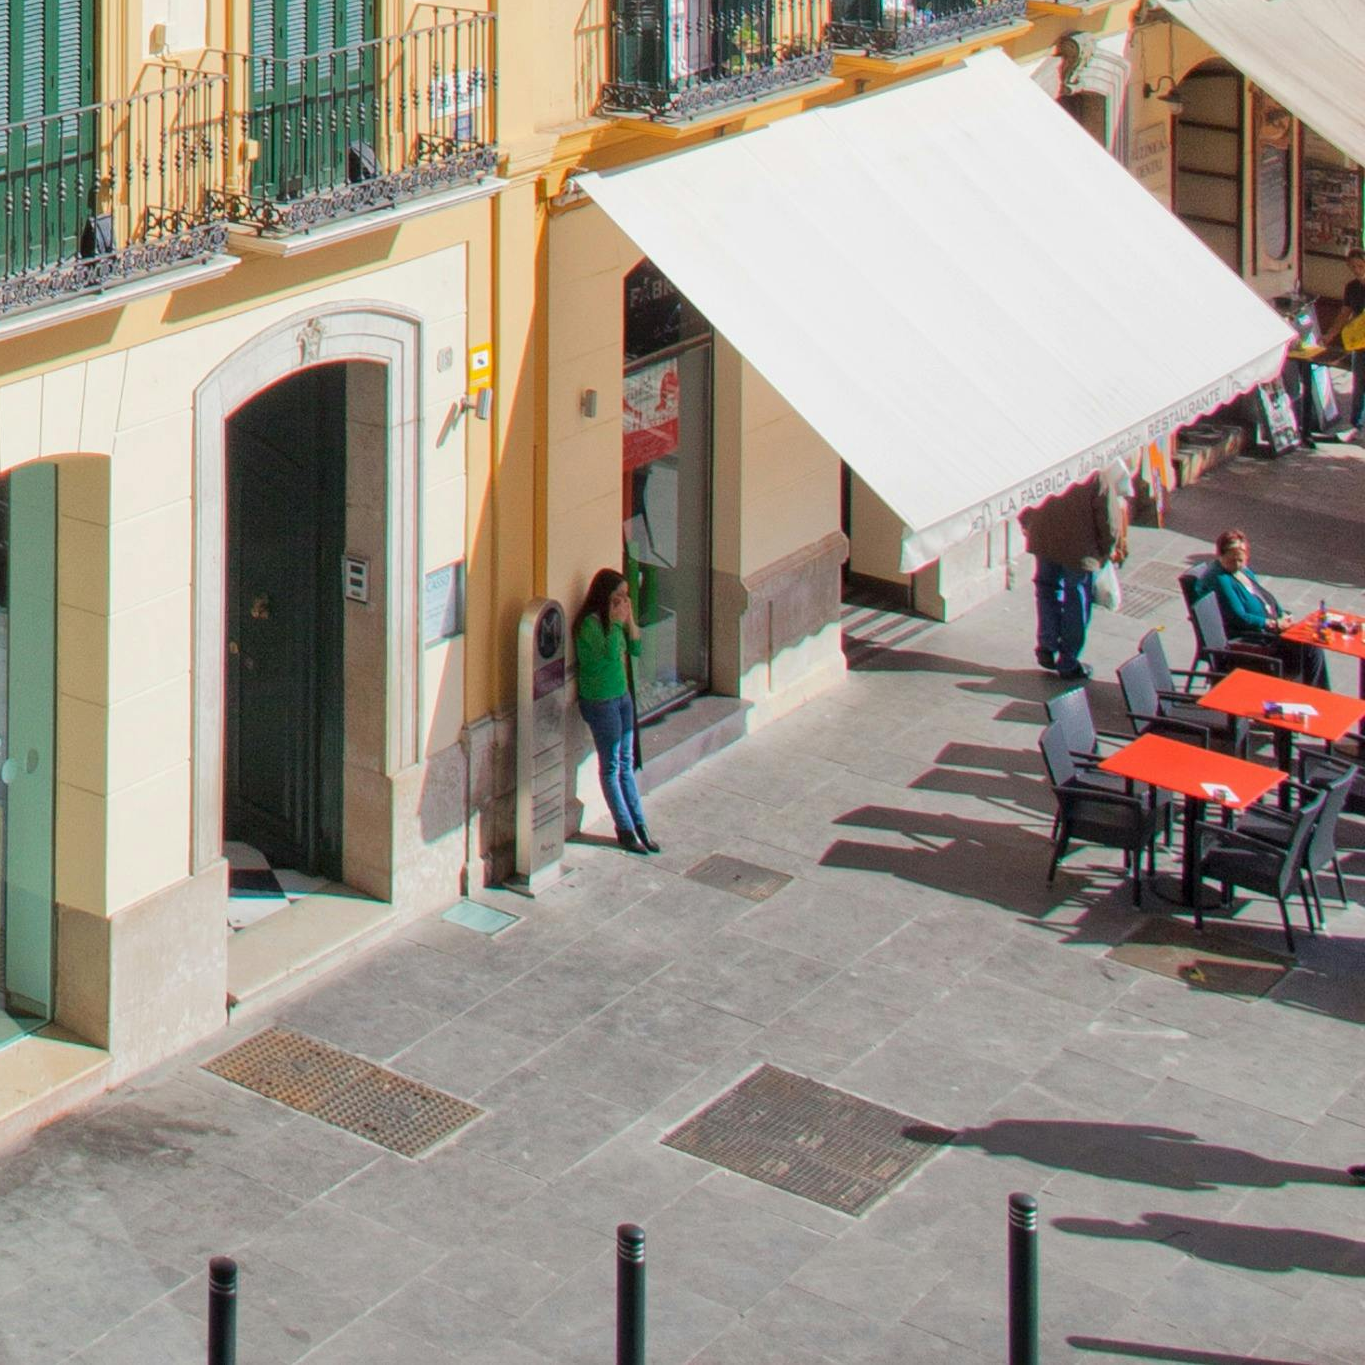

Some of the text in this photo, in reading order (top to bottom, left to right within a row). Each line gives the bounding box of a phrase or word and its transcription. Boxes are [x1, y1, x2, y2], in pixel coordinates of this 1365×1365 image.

[999, 497, 1017, 516] LA
[1020, 468, 1072, 503] FABRICA
[1147, 387, 1221, 437] RESTAURANTE
